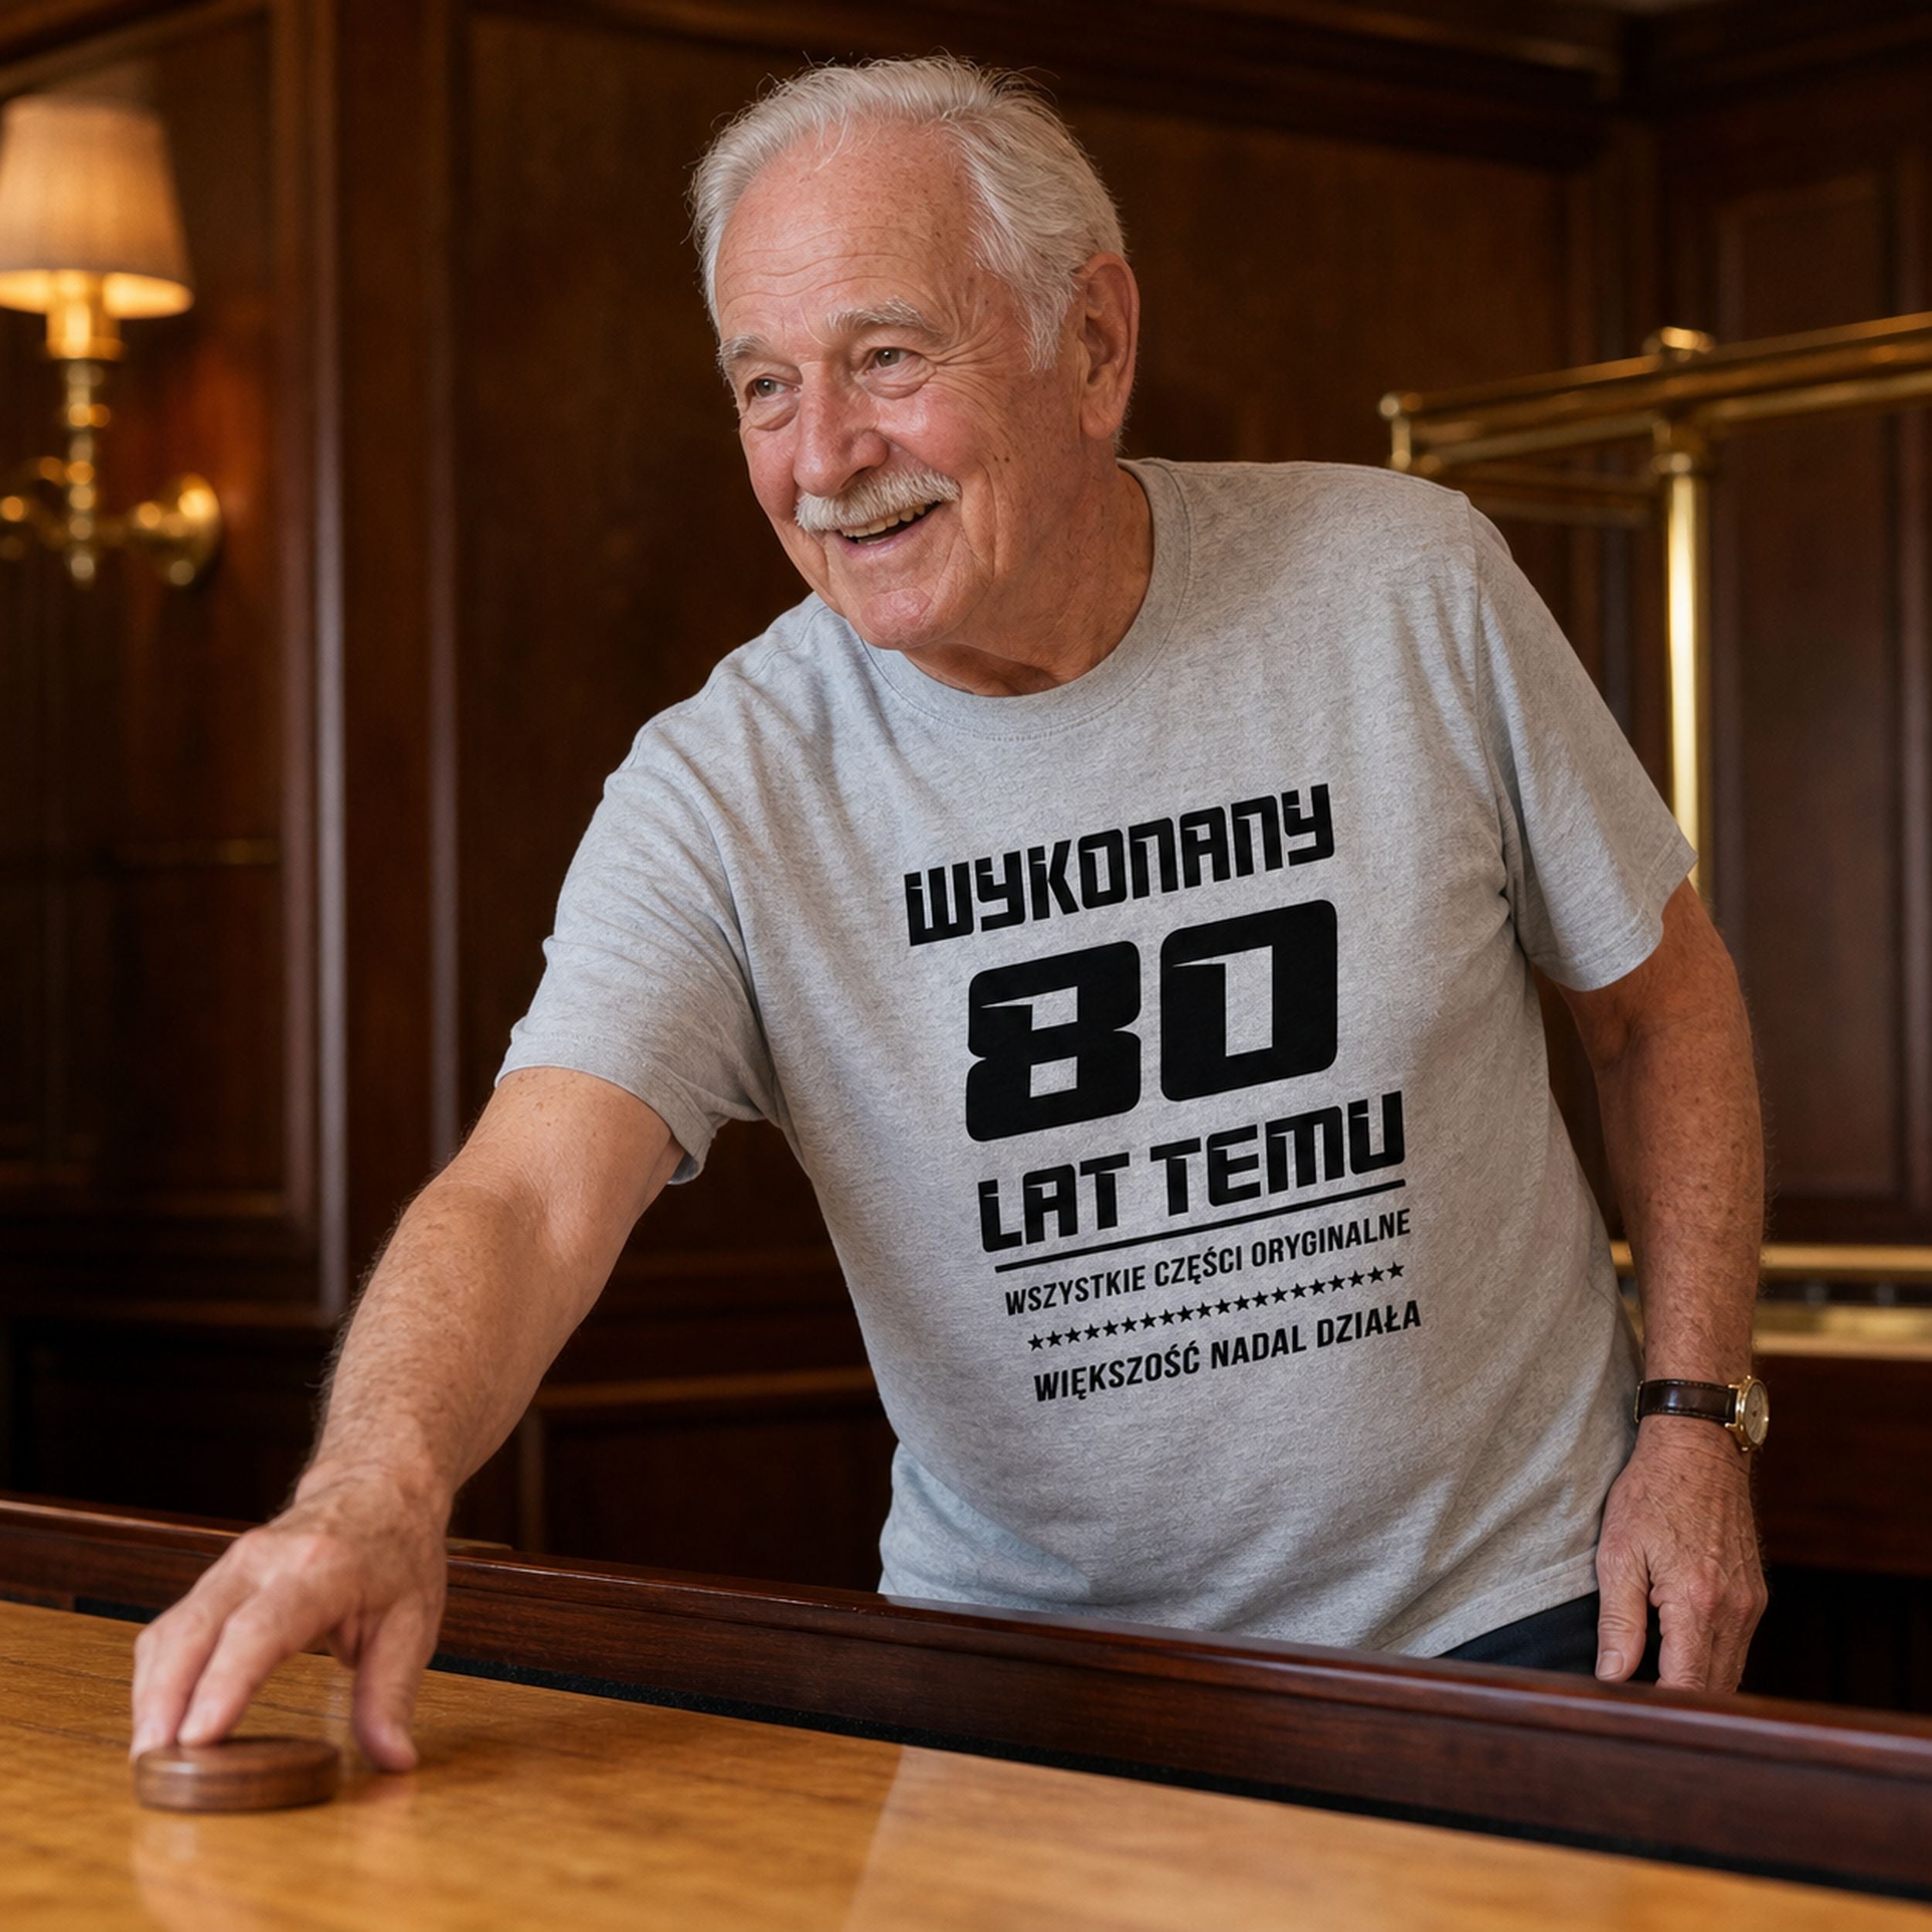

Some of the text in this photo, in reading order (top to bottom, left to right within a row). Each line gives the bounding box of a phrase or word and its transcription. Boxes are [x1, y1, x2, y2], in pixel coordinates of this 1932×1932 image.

[903, 783, 1335, 947] WYKONANY
[965, 899, 1338, 1143] 80
[977, 1090, 1406, 1253] LAT TEMU
[1005, 1207, 1411, 1317] WSZYSTKIE CZĘŚCI ORYGINALNE
[1033, 1299, 1422, 1403] WIĘKSZOŚĆ NADAL DZIAŁA
